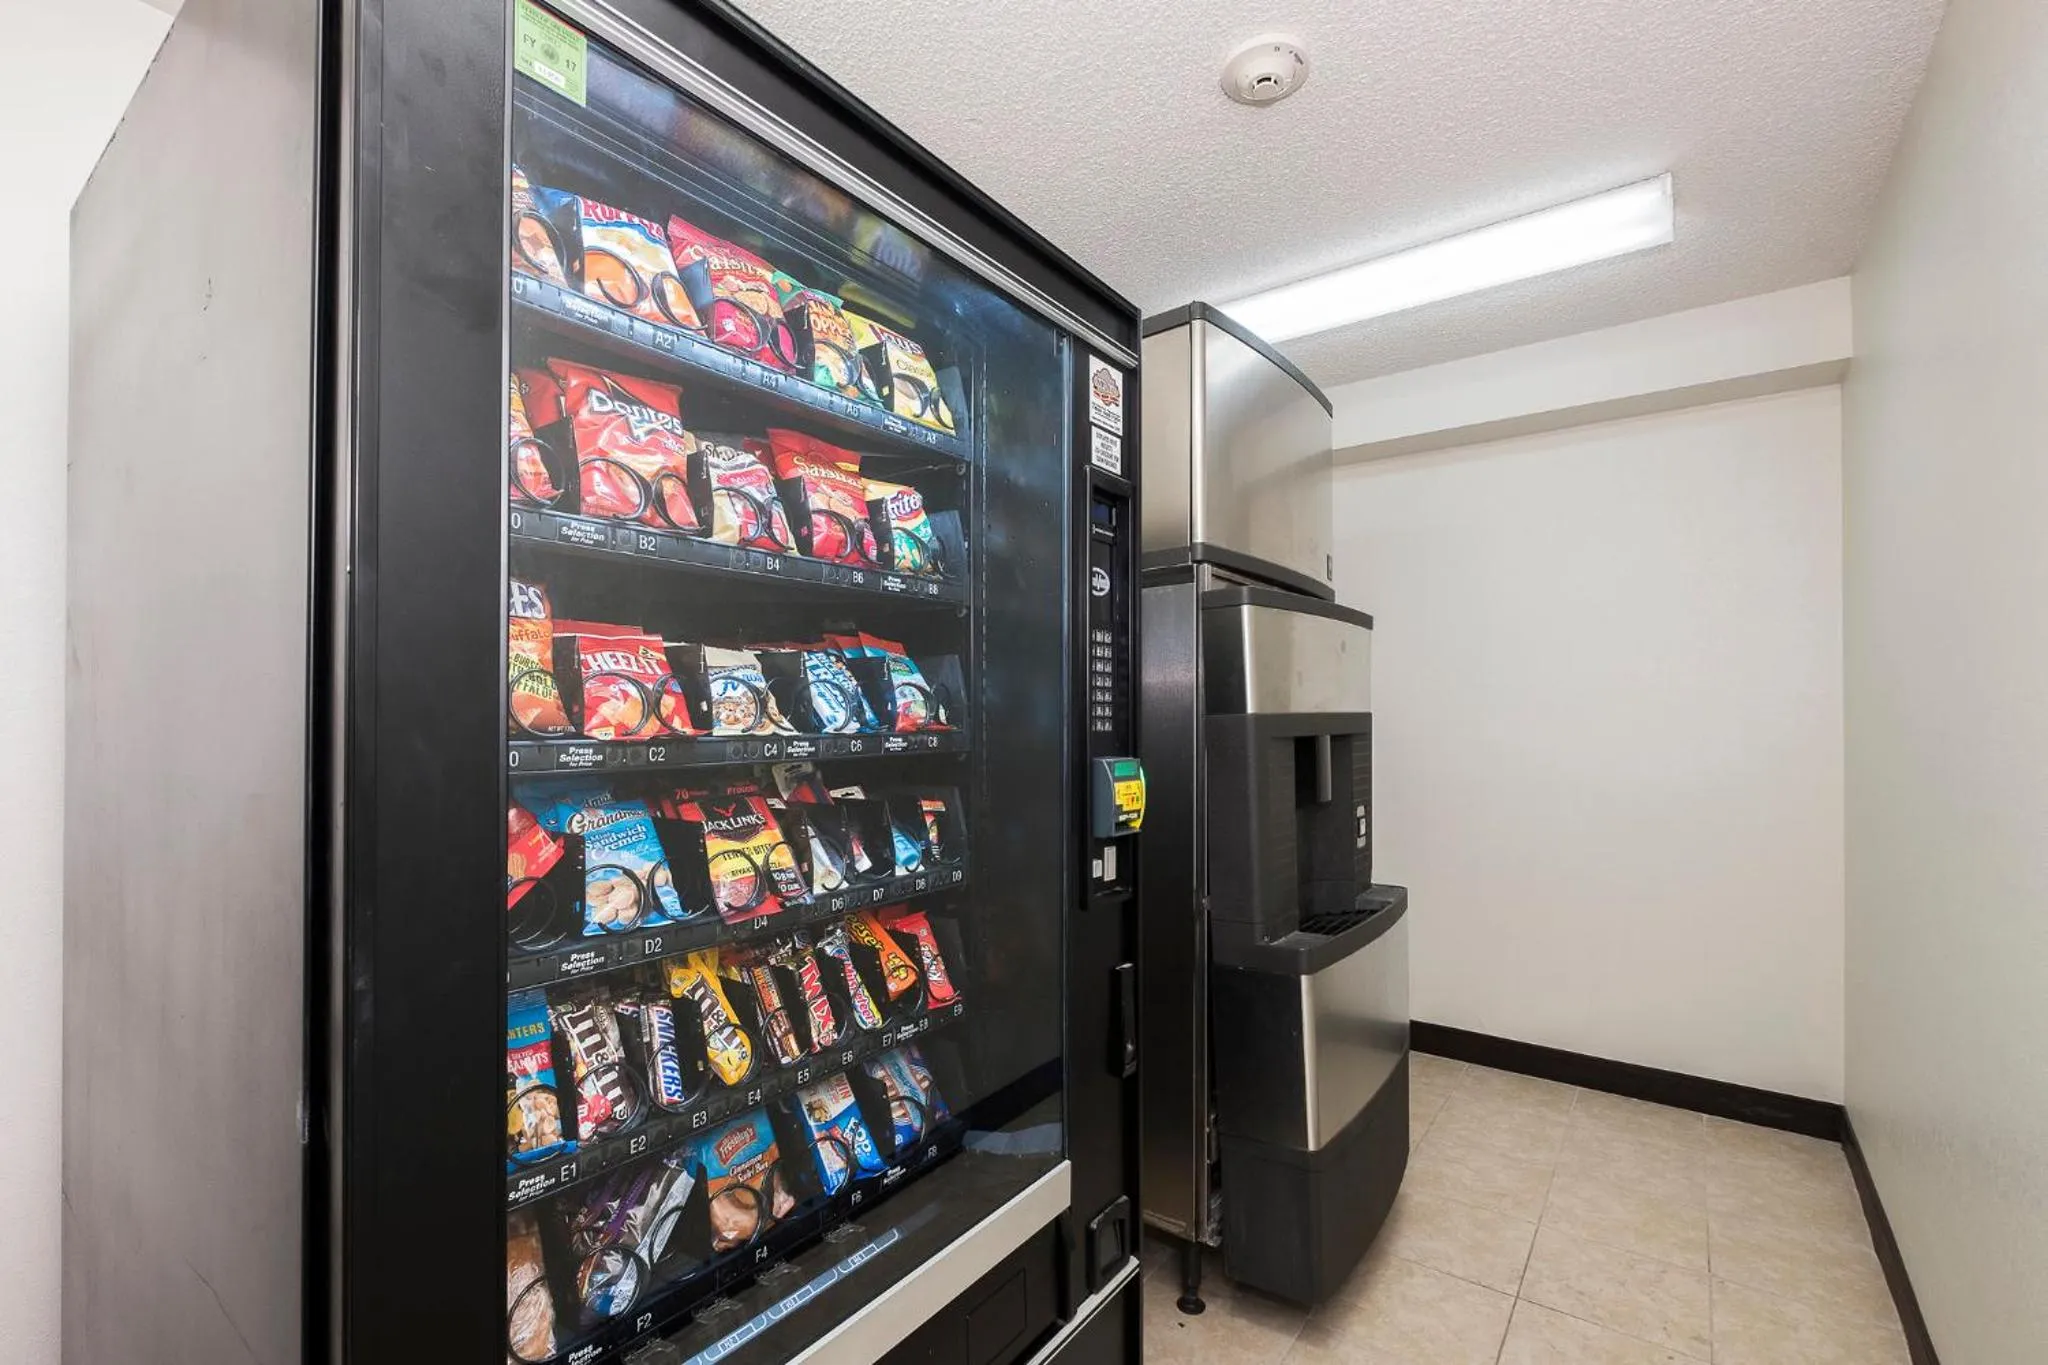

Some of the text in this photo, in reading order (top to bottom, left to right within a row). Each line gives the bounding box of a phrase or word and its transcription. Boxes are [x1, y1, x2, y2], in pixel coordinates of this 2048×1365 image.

[523, 33, 536, 47] FY
[565, 59, 576, 72] 17
[587, 387, 685, 438] Doritos
[560, 525, 604, 543] Selection
[570, 521, 596, 534] Press
[639, 534, 656, 551] B2
[766, 556, 780, 571] B4
[852, 571, 864, 584] B6
[851, 740, 863, 752] C6
[927, 736, 938, 748] C8
[569, 747, 593, 756] Press
[649, 747, 666, 762] C2
[764, 744, 778, 757] C4
[559, 754, 603, 763] Selection
[702, 818, 729, 832] JACK
[585, 823, 647, 851] Sandwich
[873, 888, 884, 900] D7
[832, 897, 844, 911] D6
[754, 917, 768, 929] D4
[645, 937, 662, 955] D2
[570, 950, 595, 962] Press
[561, 955, 605, 973] Selection
[883, 1033, 893, 1047] E7
[655, 1008, 685, 1101] SNIKERS
[842, 1051, 853, 1065] E6
[798, 1068, 810, 1085] E5
[748, 1088, 761, 1105] E4
[692, 1110, 707, 1129] E3
[630, 1135, 647, 1155] E2
[560, 1162, 577, 1182] E1
[518, 1173, 546, 1189] Press
[508, 1177, 556, 1201] Selection
[851, 1190, 863, 1206] F6
[755, 1247, 769, 1263] F4
[636, 1312, 652, 1332] F2
[568, 1344, 594, 1363] Press
